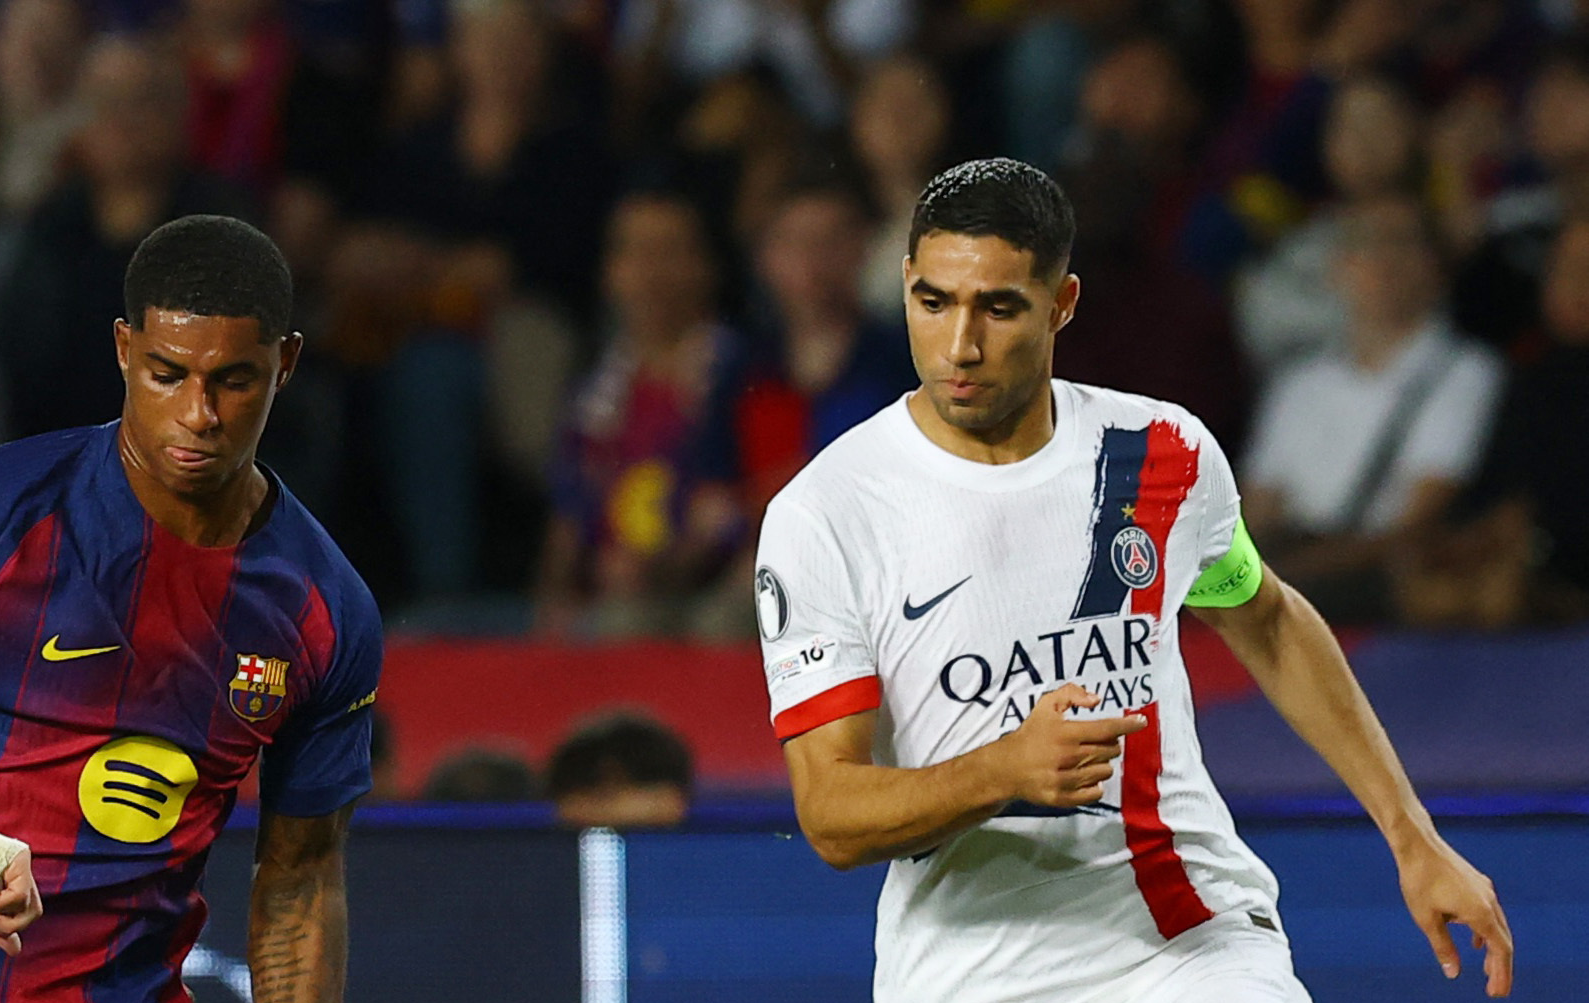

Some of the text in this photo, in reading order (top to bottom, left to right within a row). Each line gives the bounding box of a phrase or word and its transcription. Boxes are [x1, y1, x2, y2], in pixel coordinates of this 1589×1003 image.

[1117, 530, 1147, 546] PARIS
[799, 645, 825, 666] 10
[939, 618, 1152, 708] QATAR
[1001, 673, 1153, 728] AIAYS
